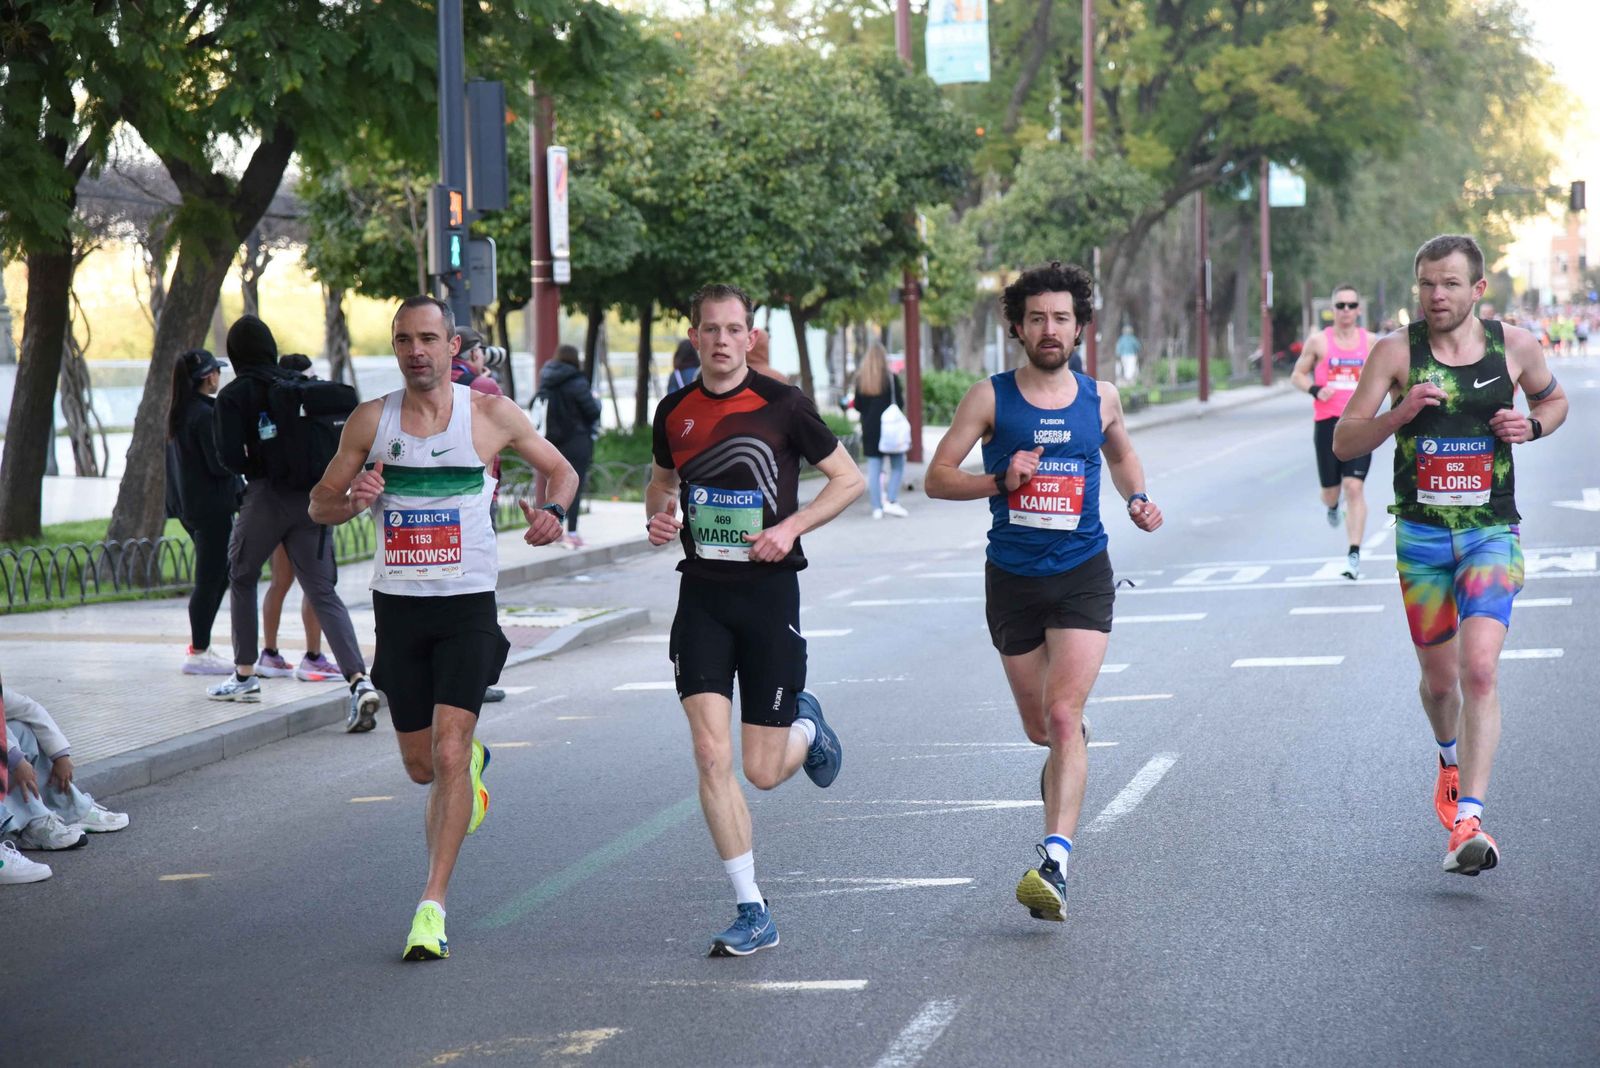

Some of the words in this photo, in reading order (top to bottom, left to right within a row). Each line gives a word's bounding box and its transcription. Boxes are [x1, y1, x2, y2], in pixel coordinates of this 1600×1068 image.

[1442, 441, 1486, 452] ZURICH
[1446, 462, 1465, 472] 652
[1036, 482, 1060, 493] 1373
[1430, 475, 1482, 490] FLORIS
[712, 493, 753, 505] ZURICH
[1020, 495, 1074, 512] KAMIEL
[407, 513, 450, 524] ZURICH
[714, 515, 732, 525] 469
[409, 534, 432, 544] 1153
[385, 547, 460, 563] WITKOWSKI
